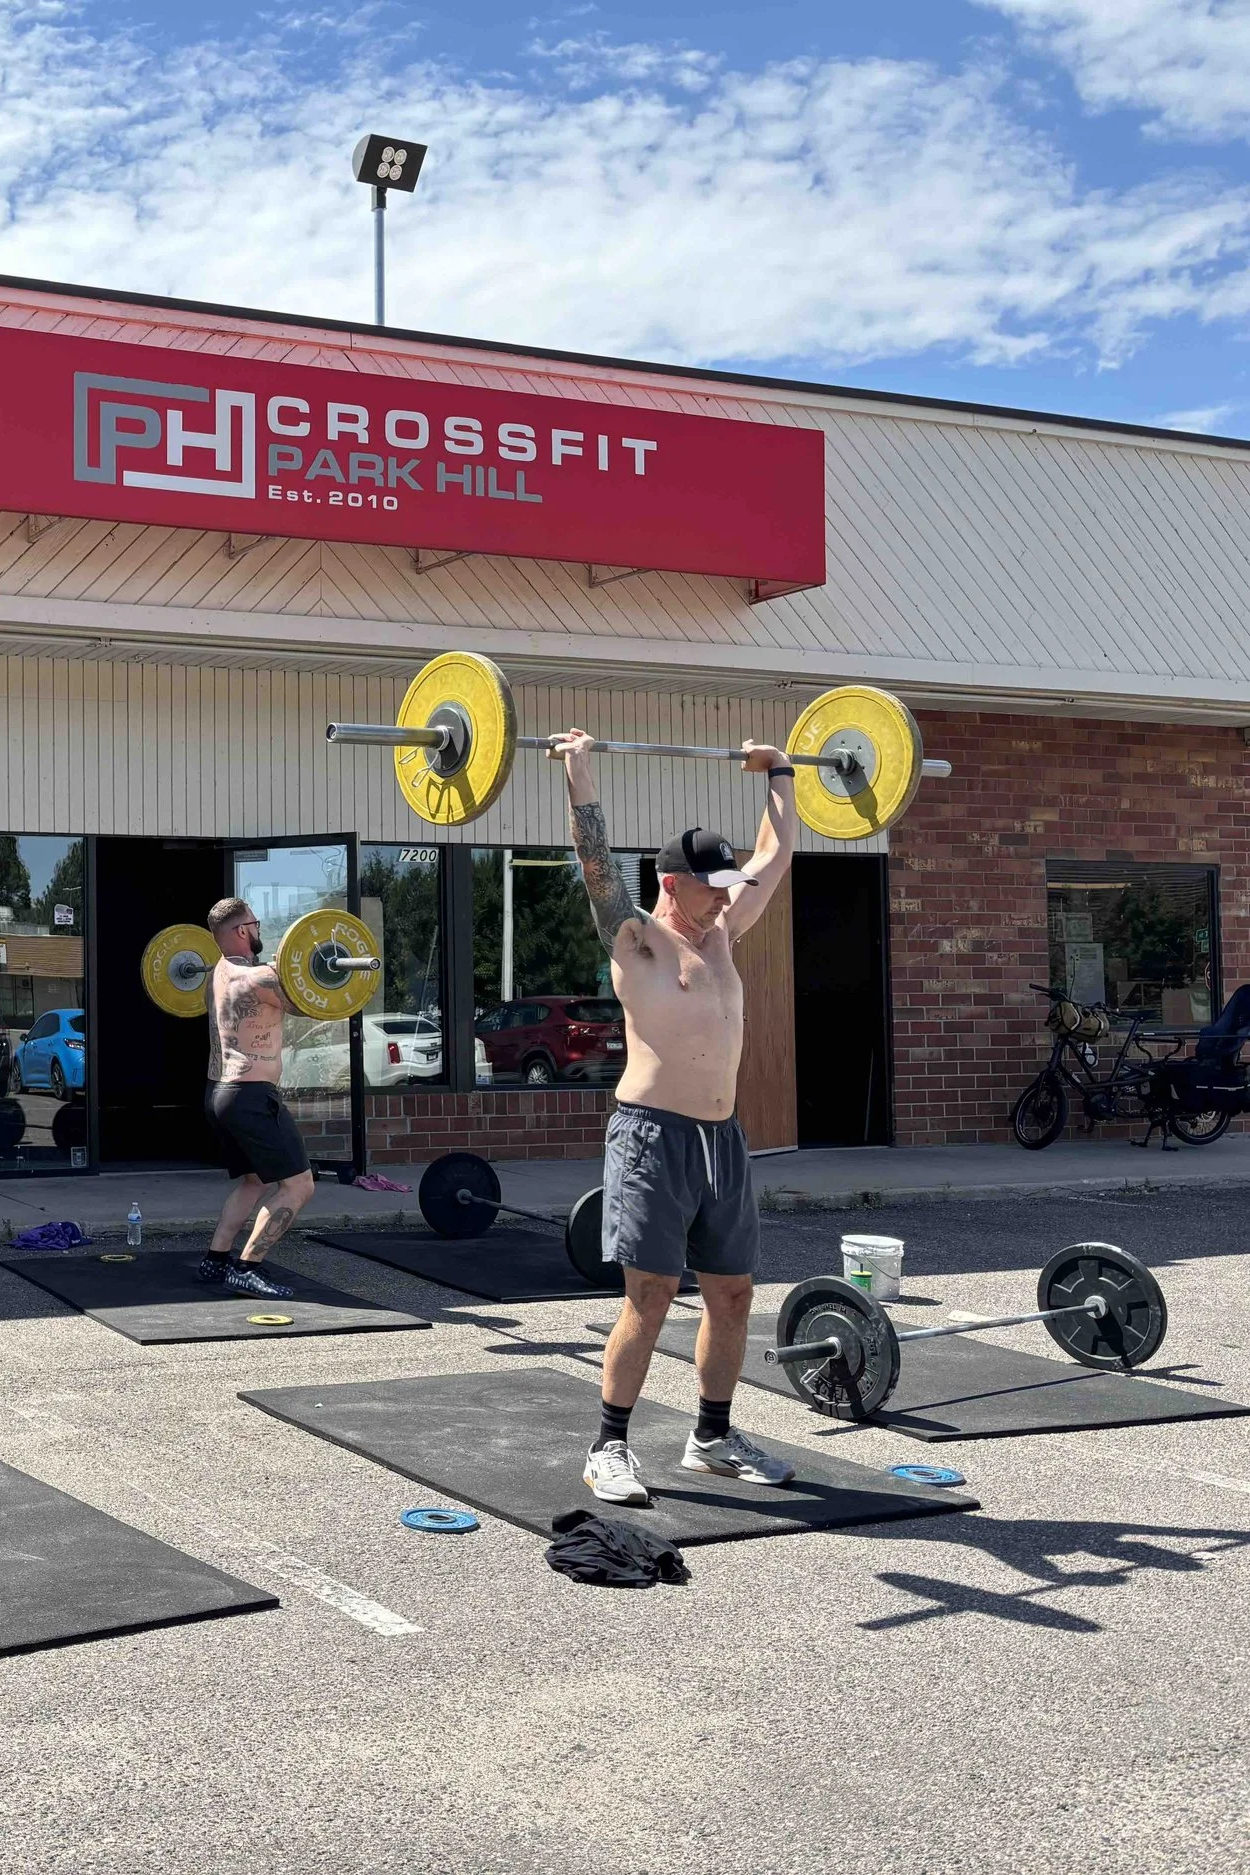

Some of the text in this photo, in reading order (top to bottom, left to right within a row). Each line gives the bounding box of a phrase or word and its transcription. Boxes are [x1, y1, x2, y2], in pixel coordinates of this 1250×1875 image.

[266, 395, 658, 476] CROSSFIT
[267, 443, 543, 503] PARK HILL
[401, 849, 437, 862] 7200
[291, 948, 329, 1009] ROGUE
